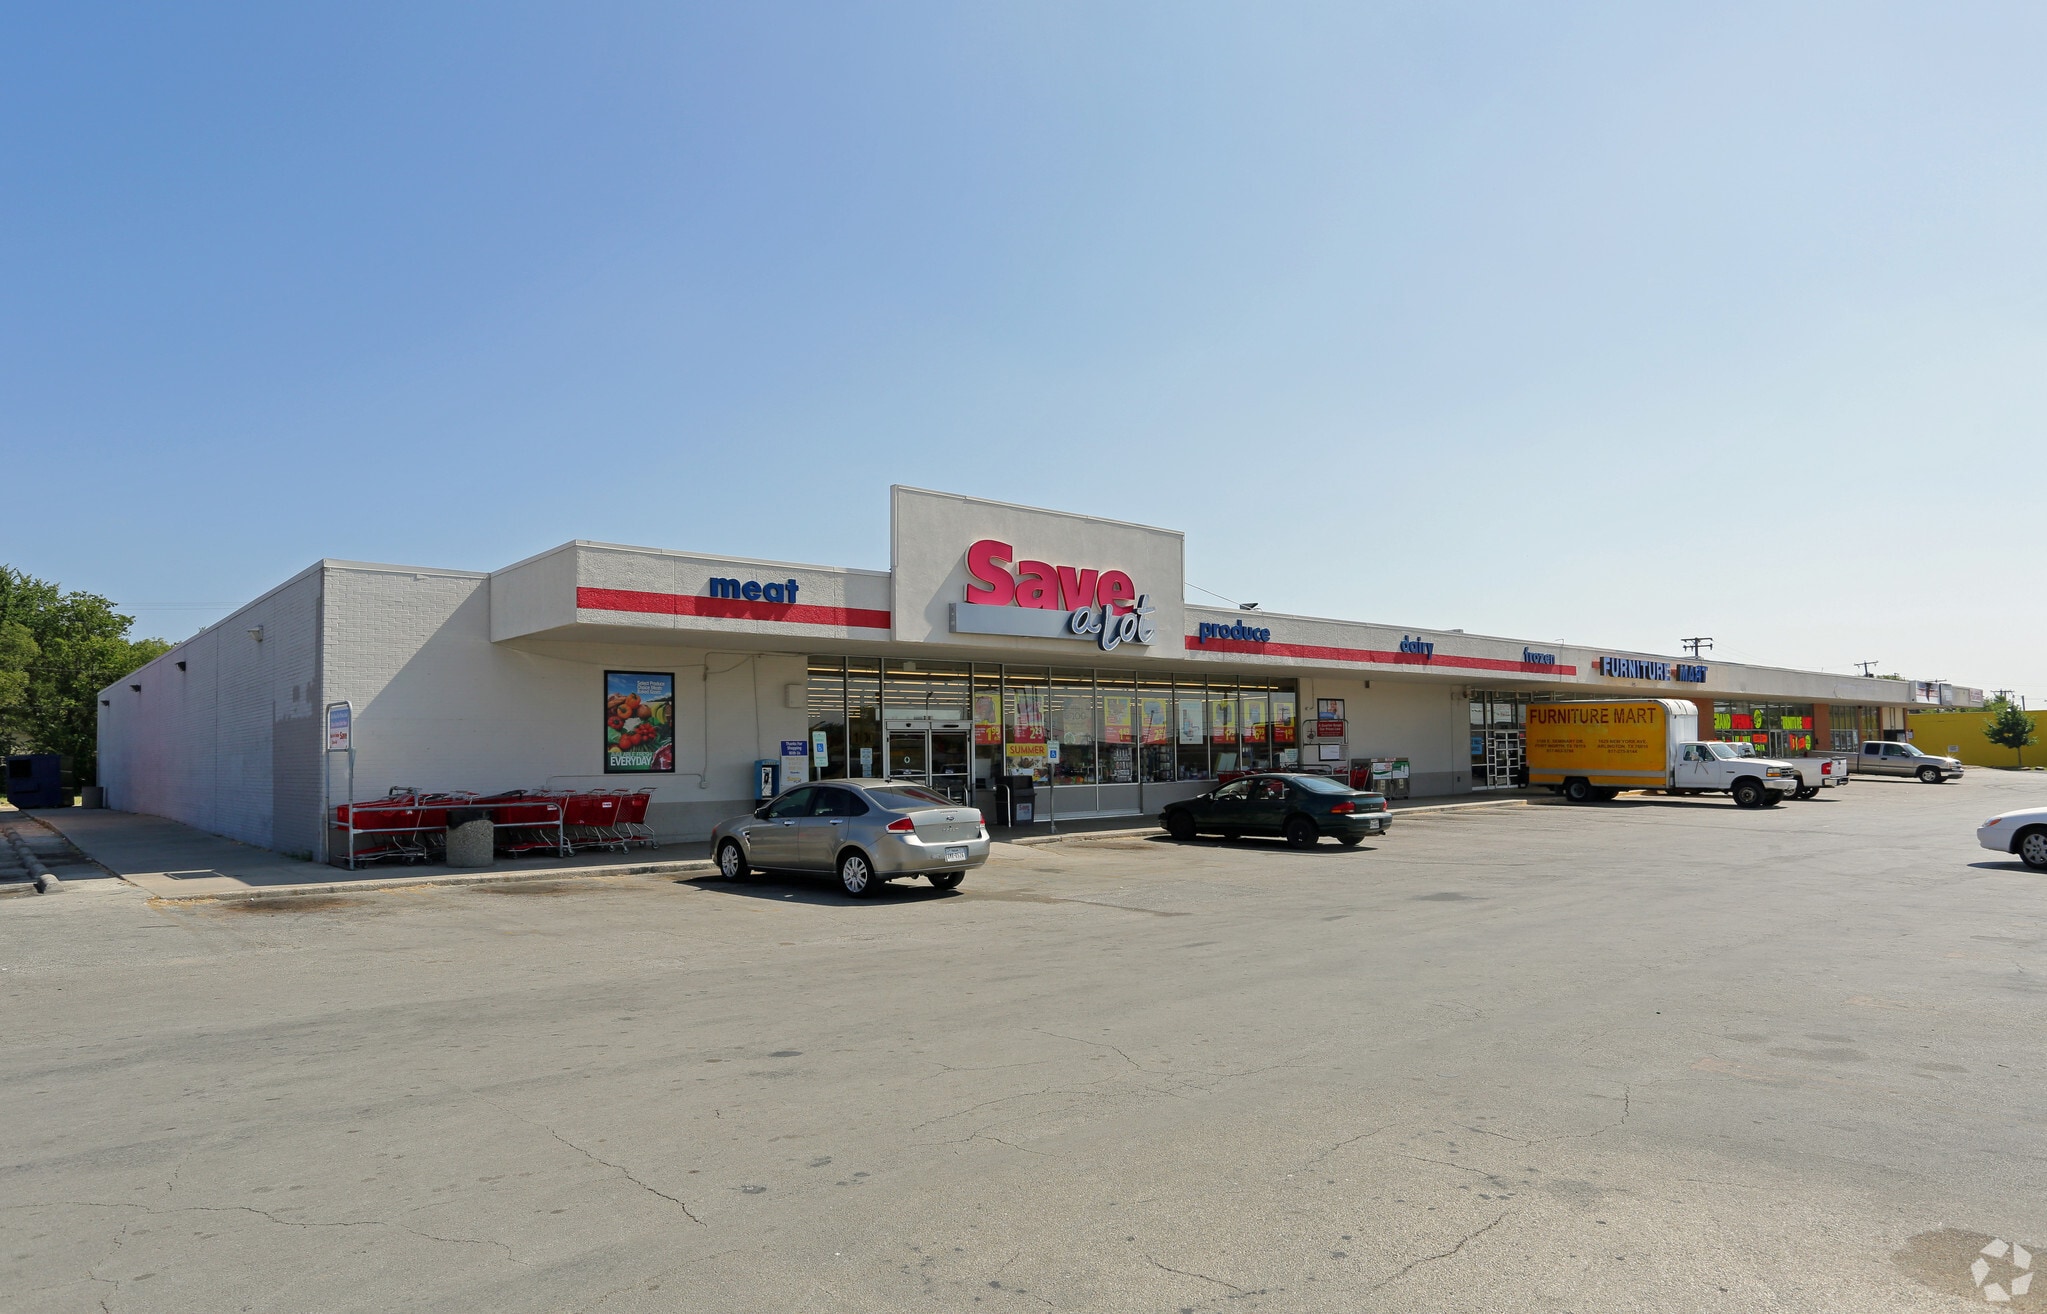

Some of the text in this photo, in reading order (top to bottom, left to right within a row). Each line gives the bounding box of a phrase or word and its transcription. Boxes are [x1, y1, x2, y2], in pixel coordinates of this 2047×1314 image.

[965, 539, 1135, 616] Save
[709, 577, 799, 604] meat
[1069, 606, 1101, 634] a
[1199, 619, 1271, 644] produce
[1400, 635, 1434, 660] dairy
[1523, 646, 1555, 665] frozen
[1600, 656, 1708, 683] FURNITURE MART
[1530, 708, 1608, 724] FURNITURE
[1614, 708, 1656, 724] MART
[610, 756, 651, 766] EVERYDAY
[1010, 745, 1045, 754] SUMMER
